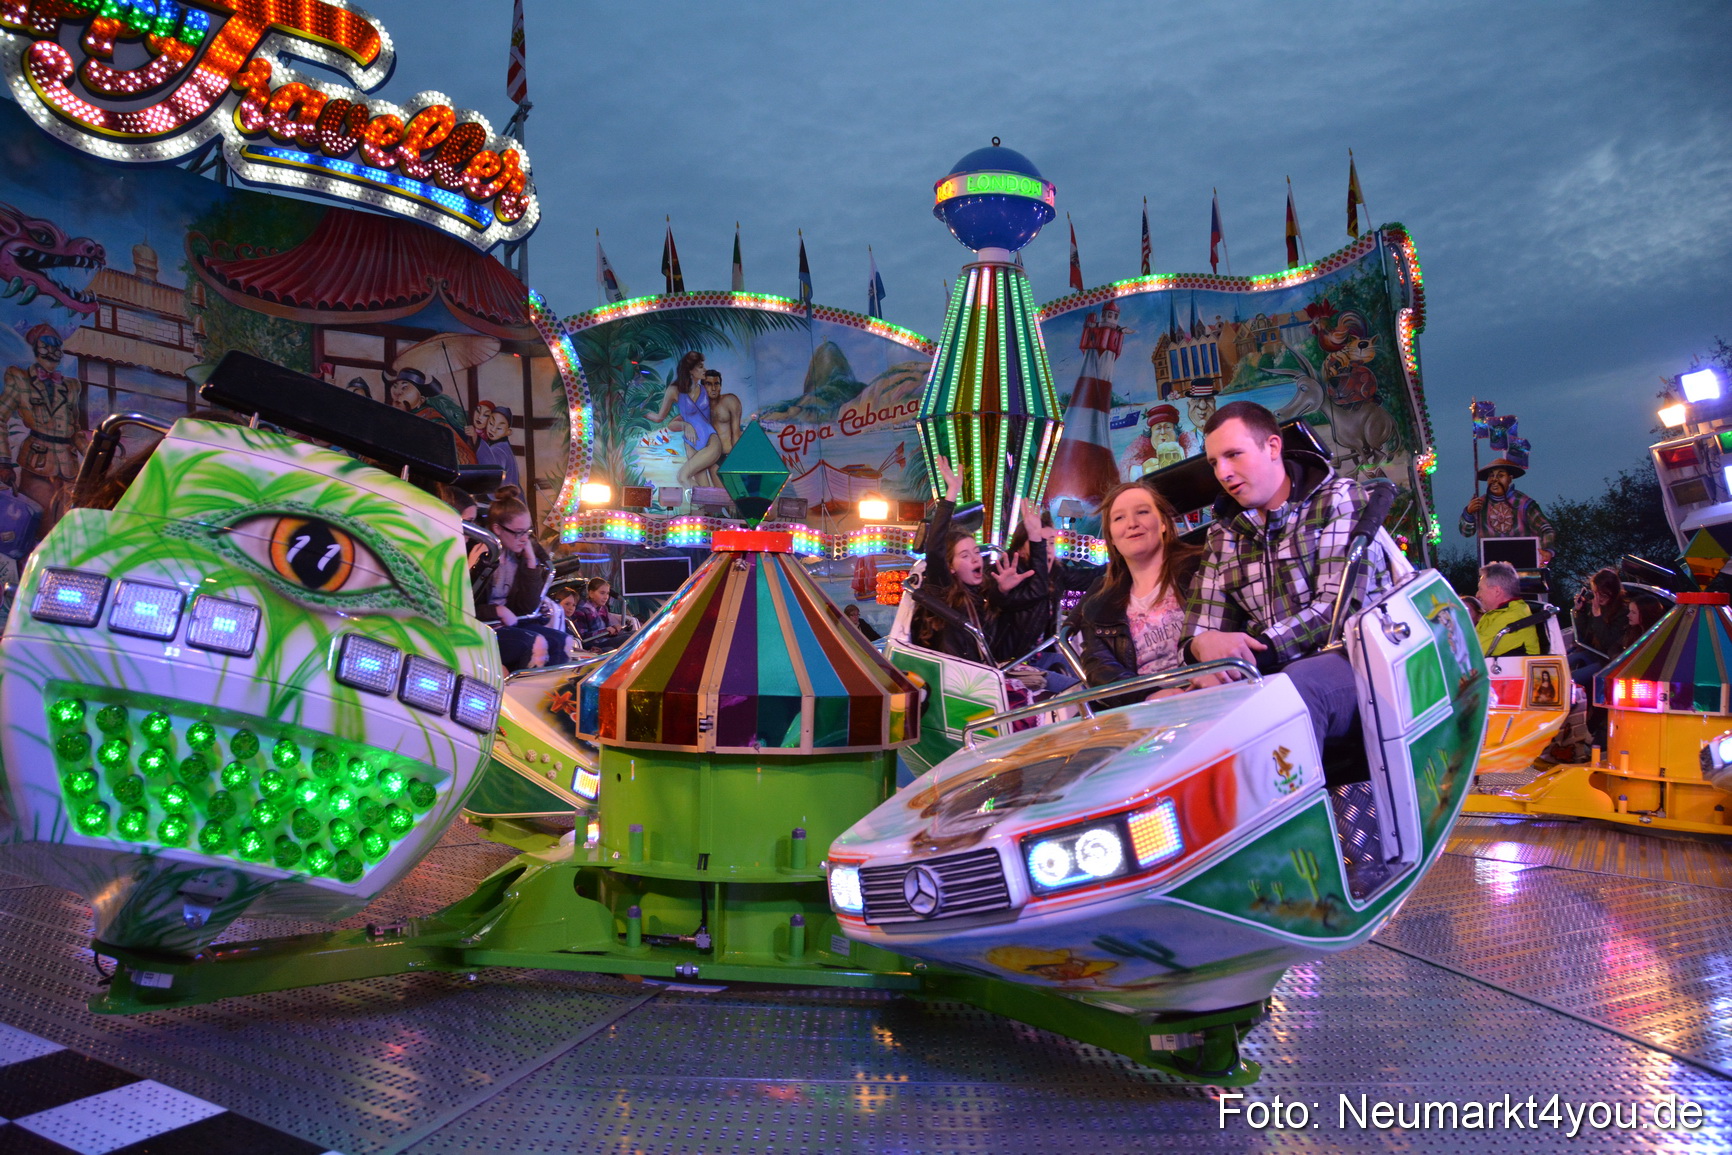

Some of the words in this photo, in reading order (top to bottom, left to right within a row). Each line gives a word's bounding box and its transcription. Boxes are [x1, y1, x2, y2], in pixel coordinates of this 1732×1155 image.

[966, 174, 1042, 196] LONDON
[777, 424, 834, 455] Copa
[838, 400, 920, 436] Cabana
